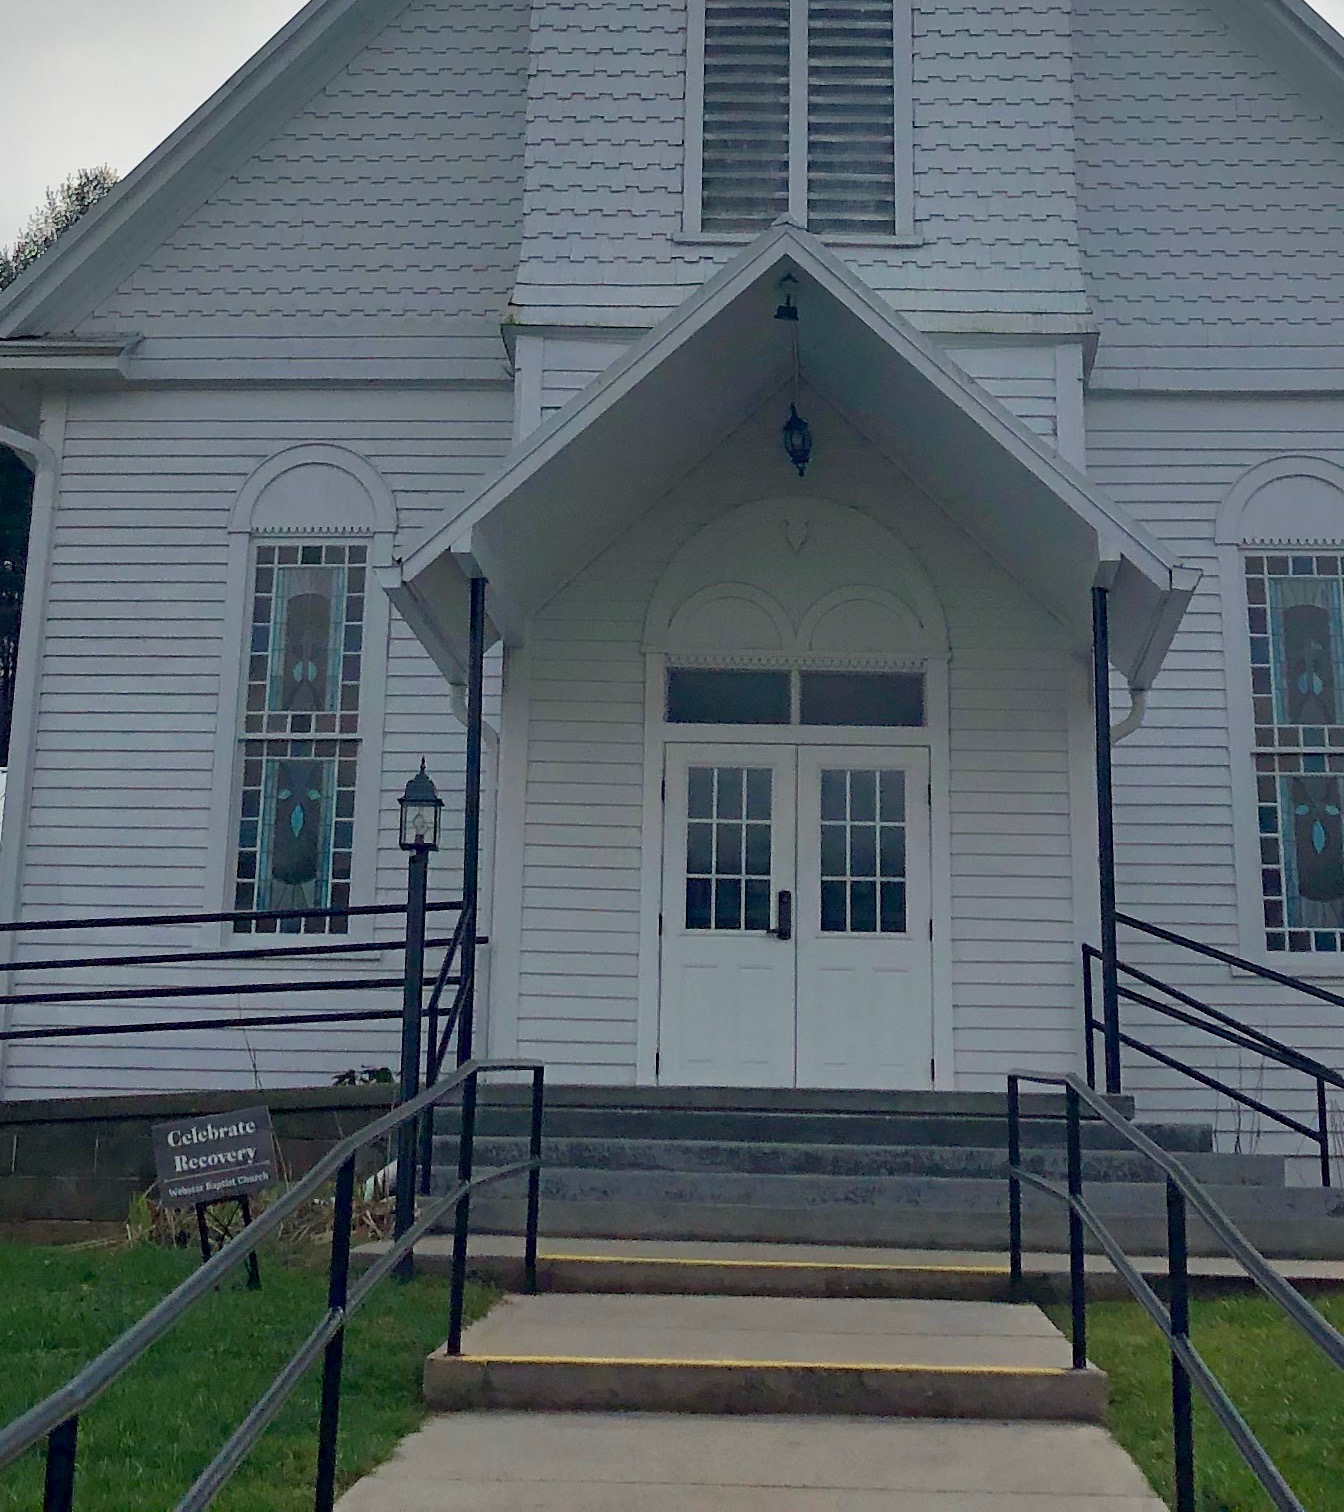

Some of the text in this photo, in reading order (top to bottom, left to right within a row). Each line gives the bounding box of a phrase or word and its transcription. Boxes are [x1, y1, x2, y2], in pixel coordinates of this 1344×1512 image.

[167, 1121, 256, 1147] Celebrate
[175, 1147, 257, 1172] Recovery
[206, 1178, 236, 1190] Baptist
[238, 1171, 269, 1184] Church
